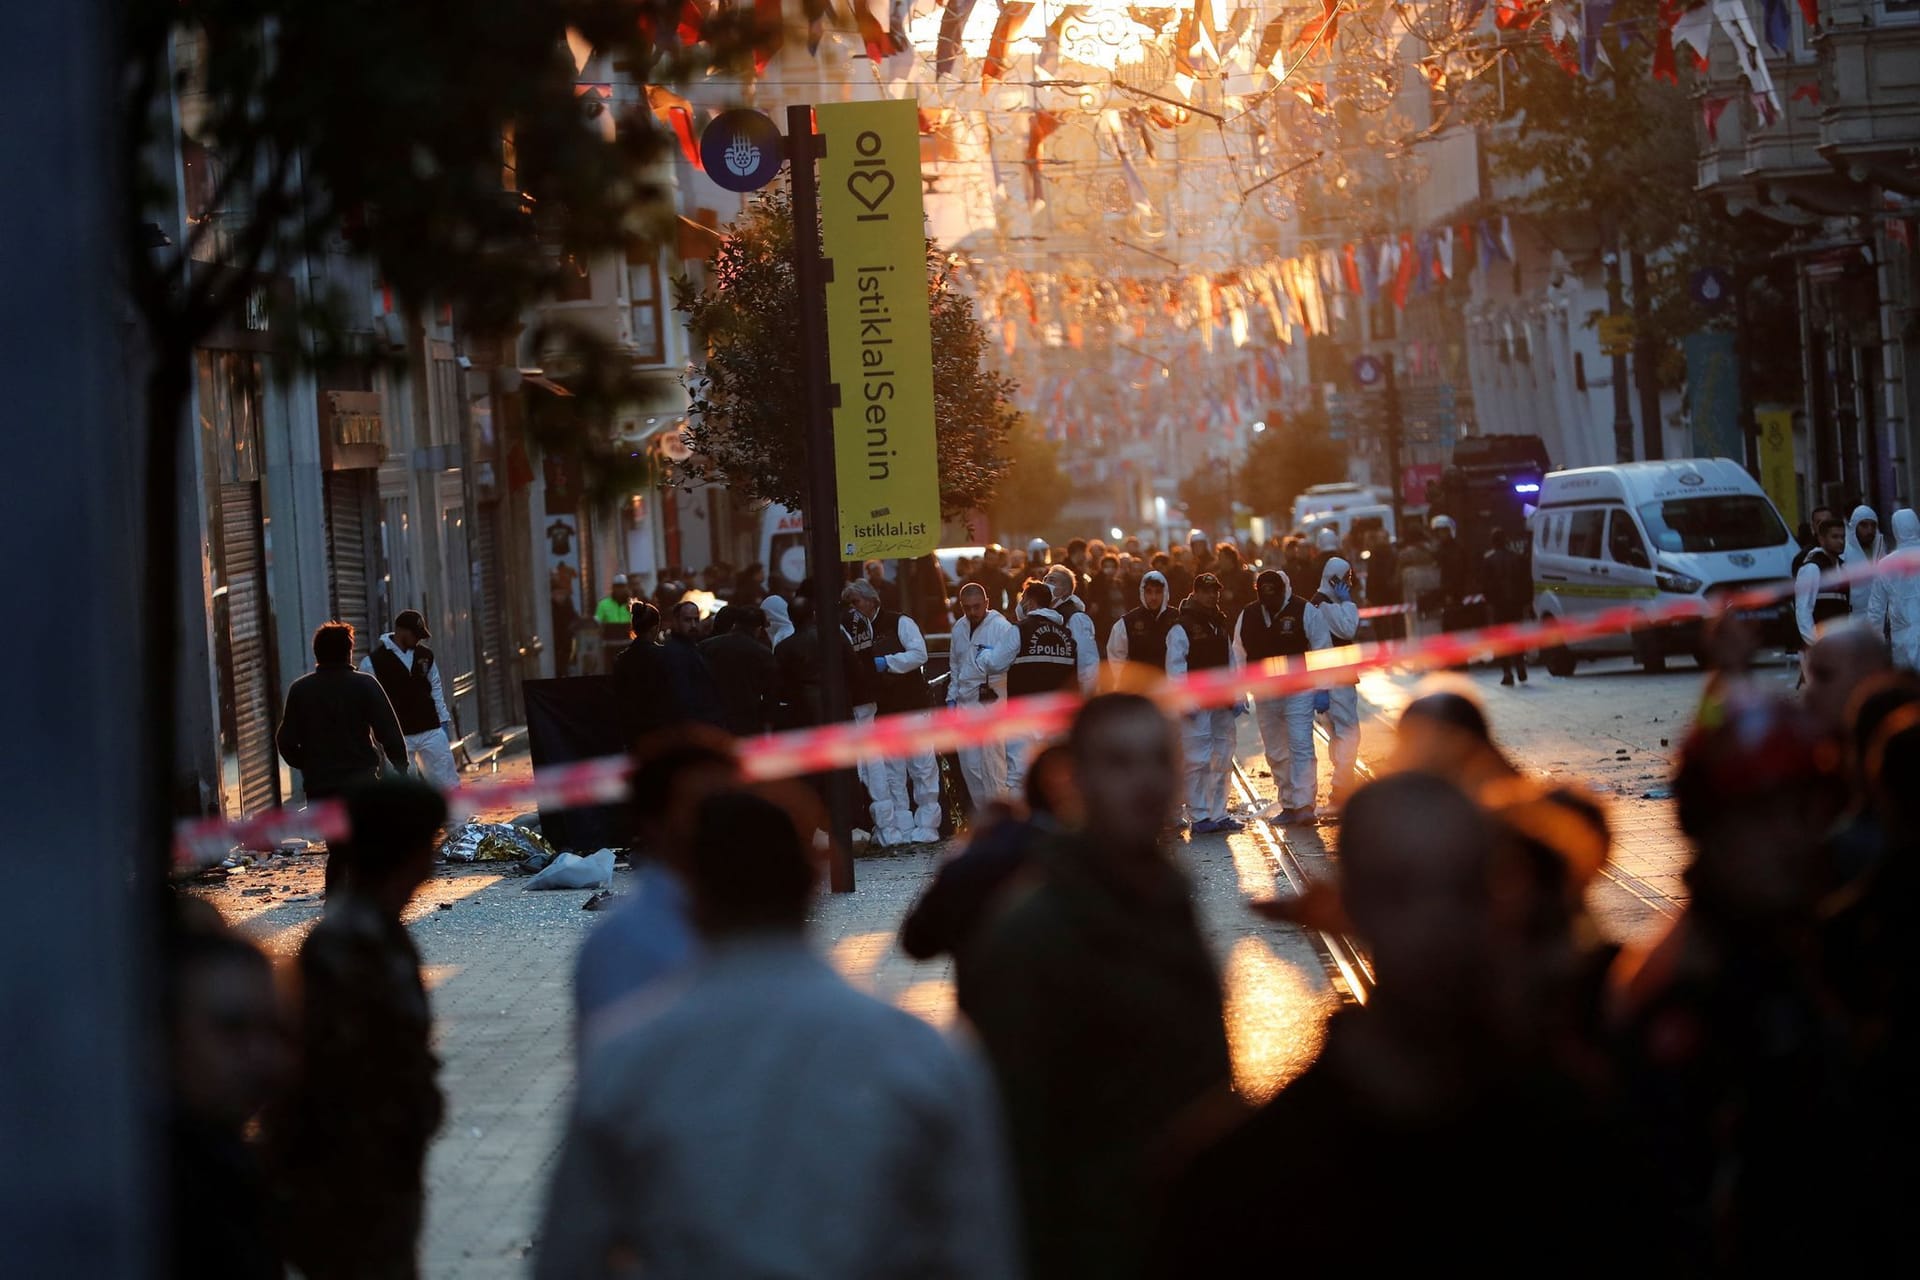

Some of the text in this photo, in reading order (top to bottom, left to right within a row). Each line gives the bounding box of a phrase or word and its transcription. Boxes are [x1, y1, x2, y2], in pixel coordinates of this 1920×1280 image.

[857, 265, 897, 481] istiklalSenin
[854, 521, 926, 538] istiklal.ist
[1036, 643, 1066, 657] POLİS
